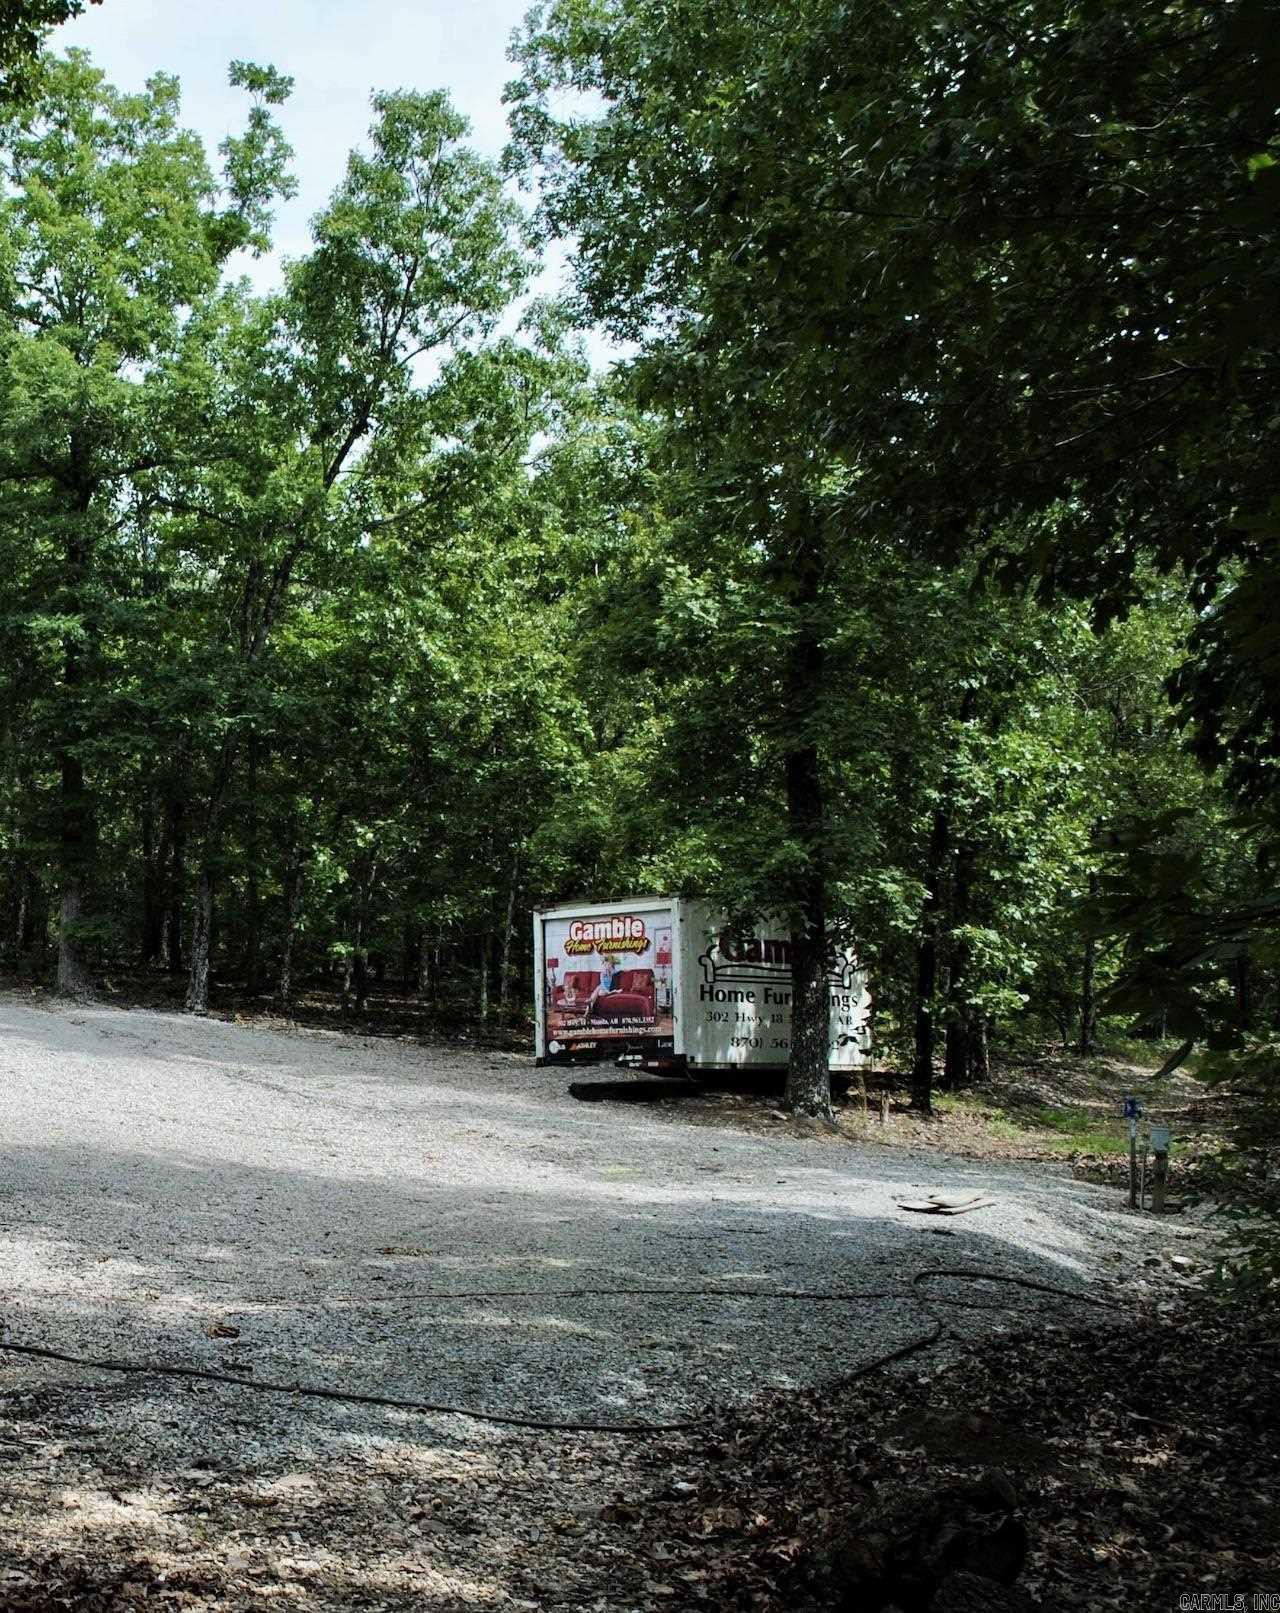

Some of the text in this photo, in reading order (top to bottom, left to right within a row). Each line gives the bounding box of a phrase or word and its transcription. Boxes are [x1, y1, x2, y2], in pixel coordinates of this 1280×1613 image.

[570, 917, 644, 941] Gamble
[565, 940, 593, 953] Home
[700, 984, 756, 1004] Home
[706, 1011, 728, 1022] 302
[735, 1012, 764, 1026] Hwy
